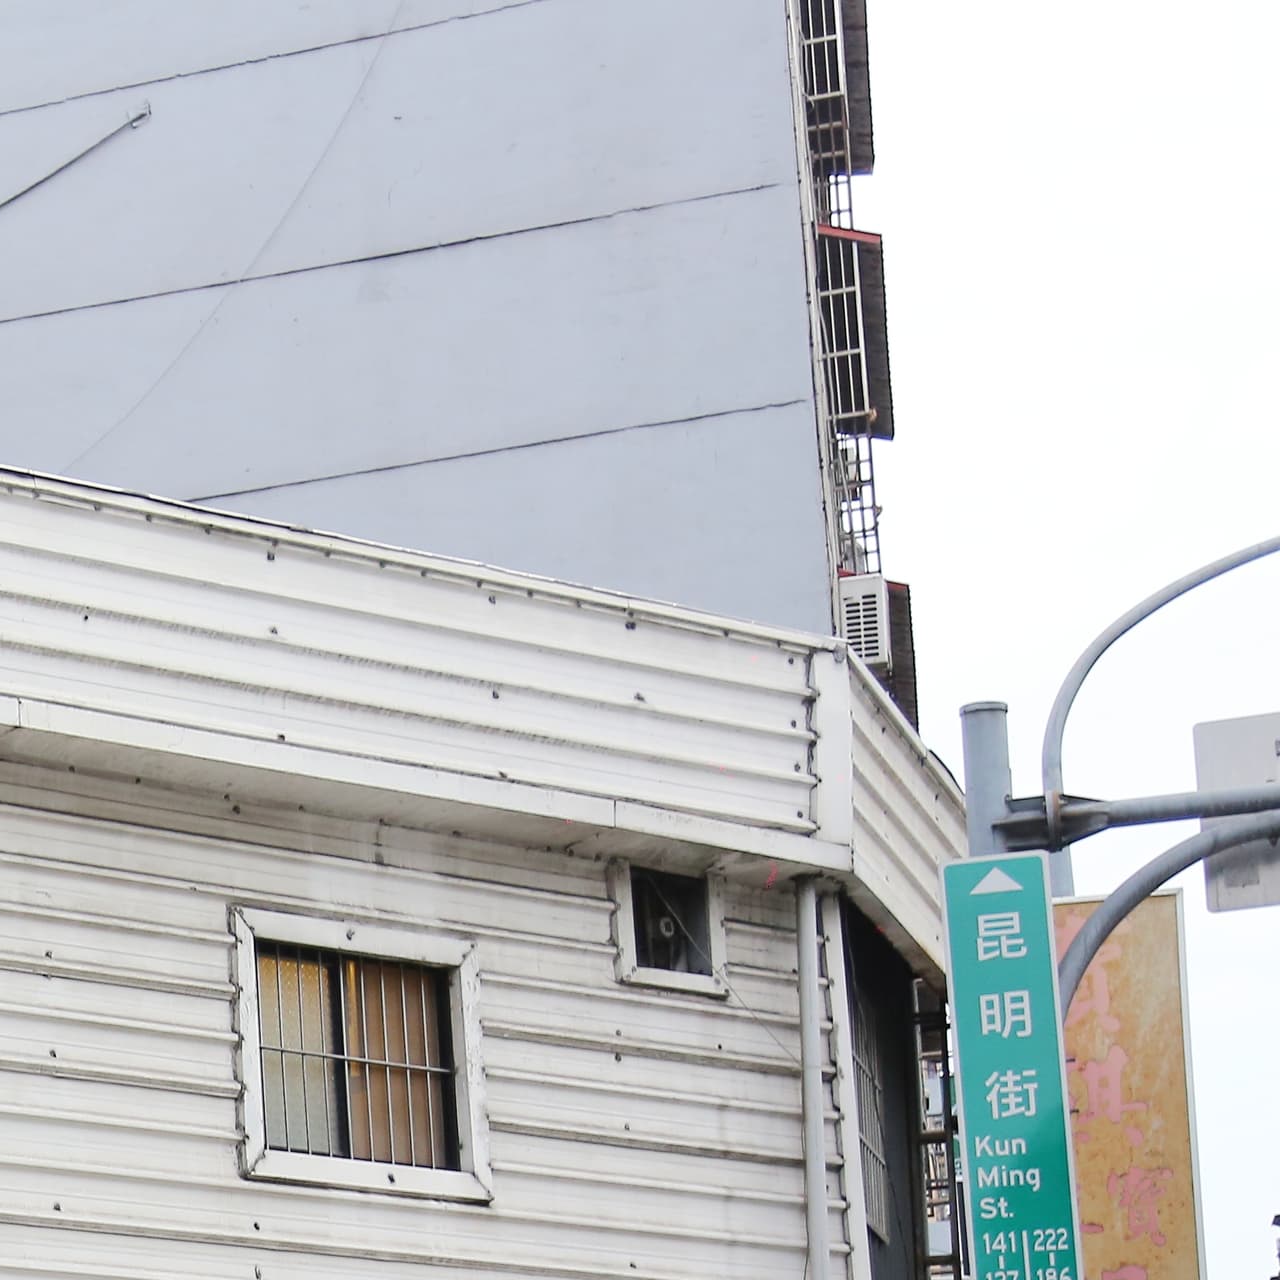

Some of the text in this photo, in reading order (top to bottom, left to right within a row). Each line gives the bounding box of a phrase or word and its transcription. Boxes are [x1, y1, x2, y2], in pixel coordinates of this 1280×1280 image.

[975, 911, 1039, 1121] 昆明街
[975, 1134, 1028, 1158] Kun
[977, 1165, 1041, 1192] Ming
[979, 1197, 1015, 1220] St.
[982, 1230, 1018, 1255] 141
[1033, 1229, 1069, 1252] 222
